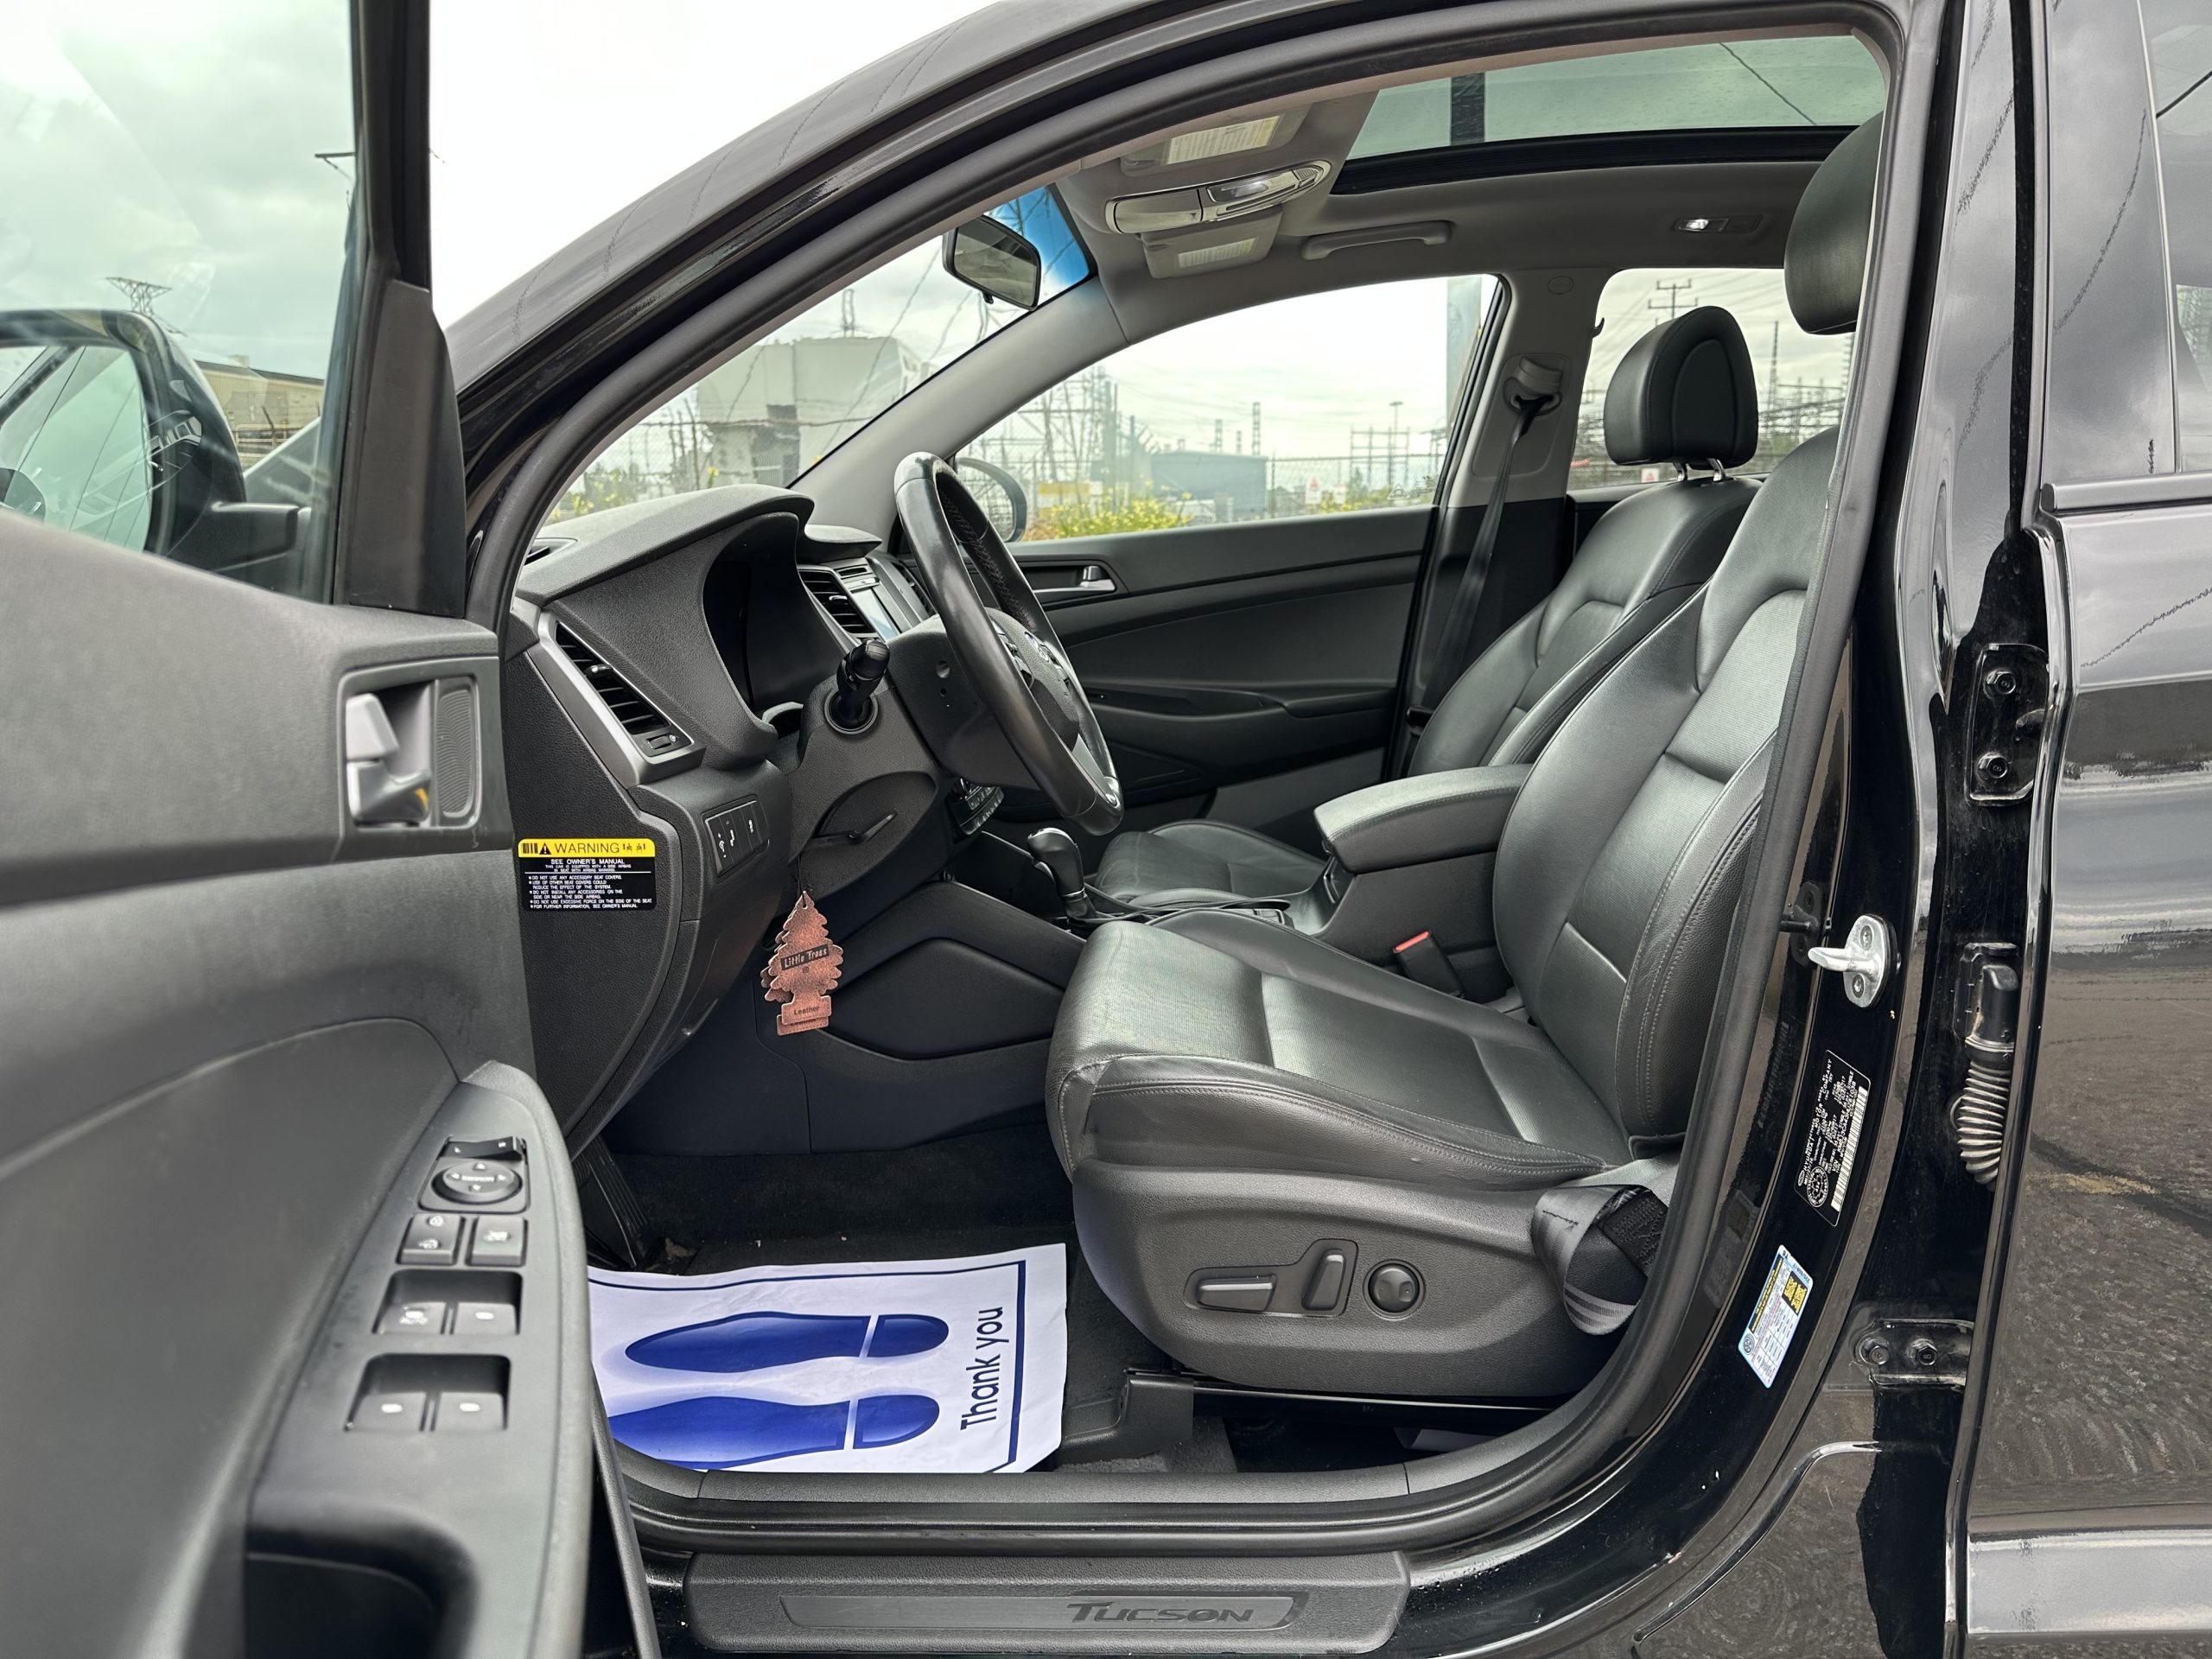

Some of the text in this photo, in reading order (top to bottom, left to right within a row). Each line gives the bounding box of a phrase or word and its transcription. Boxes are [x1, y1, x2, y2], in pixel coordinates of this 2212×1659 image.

[555, 843, 619, 854] WARNING
[784, 948, 828, 968] Little Trees
[794, 1005, 820, 1015] Leather
[1804, 1137, 1815, 1170] HYUNDAI
[1815, 1103, 1823, 1128] MOTOR
[1823, 1058, 1832, 1093] COMPANY
[400, 1316, 428, 1325] AUTO
[960, 1306, 1009, 1431] Thank you
[1067, 1601, 1254, 1623] TUCSON
